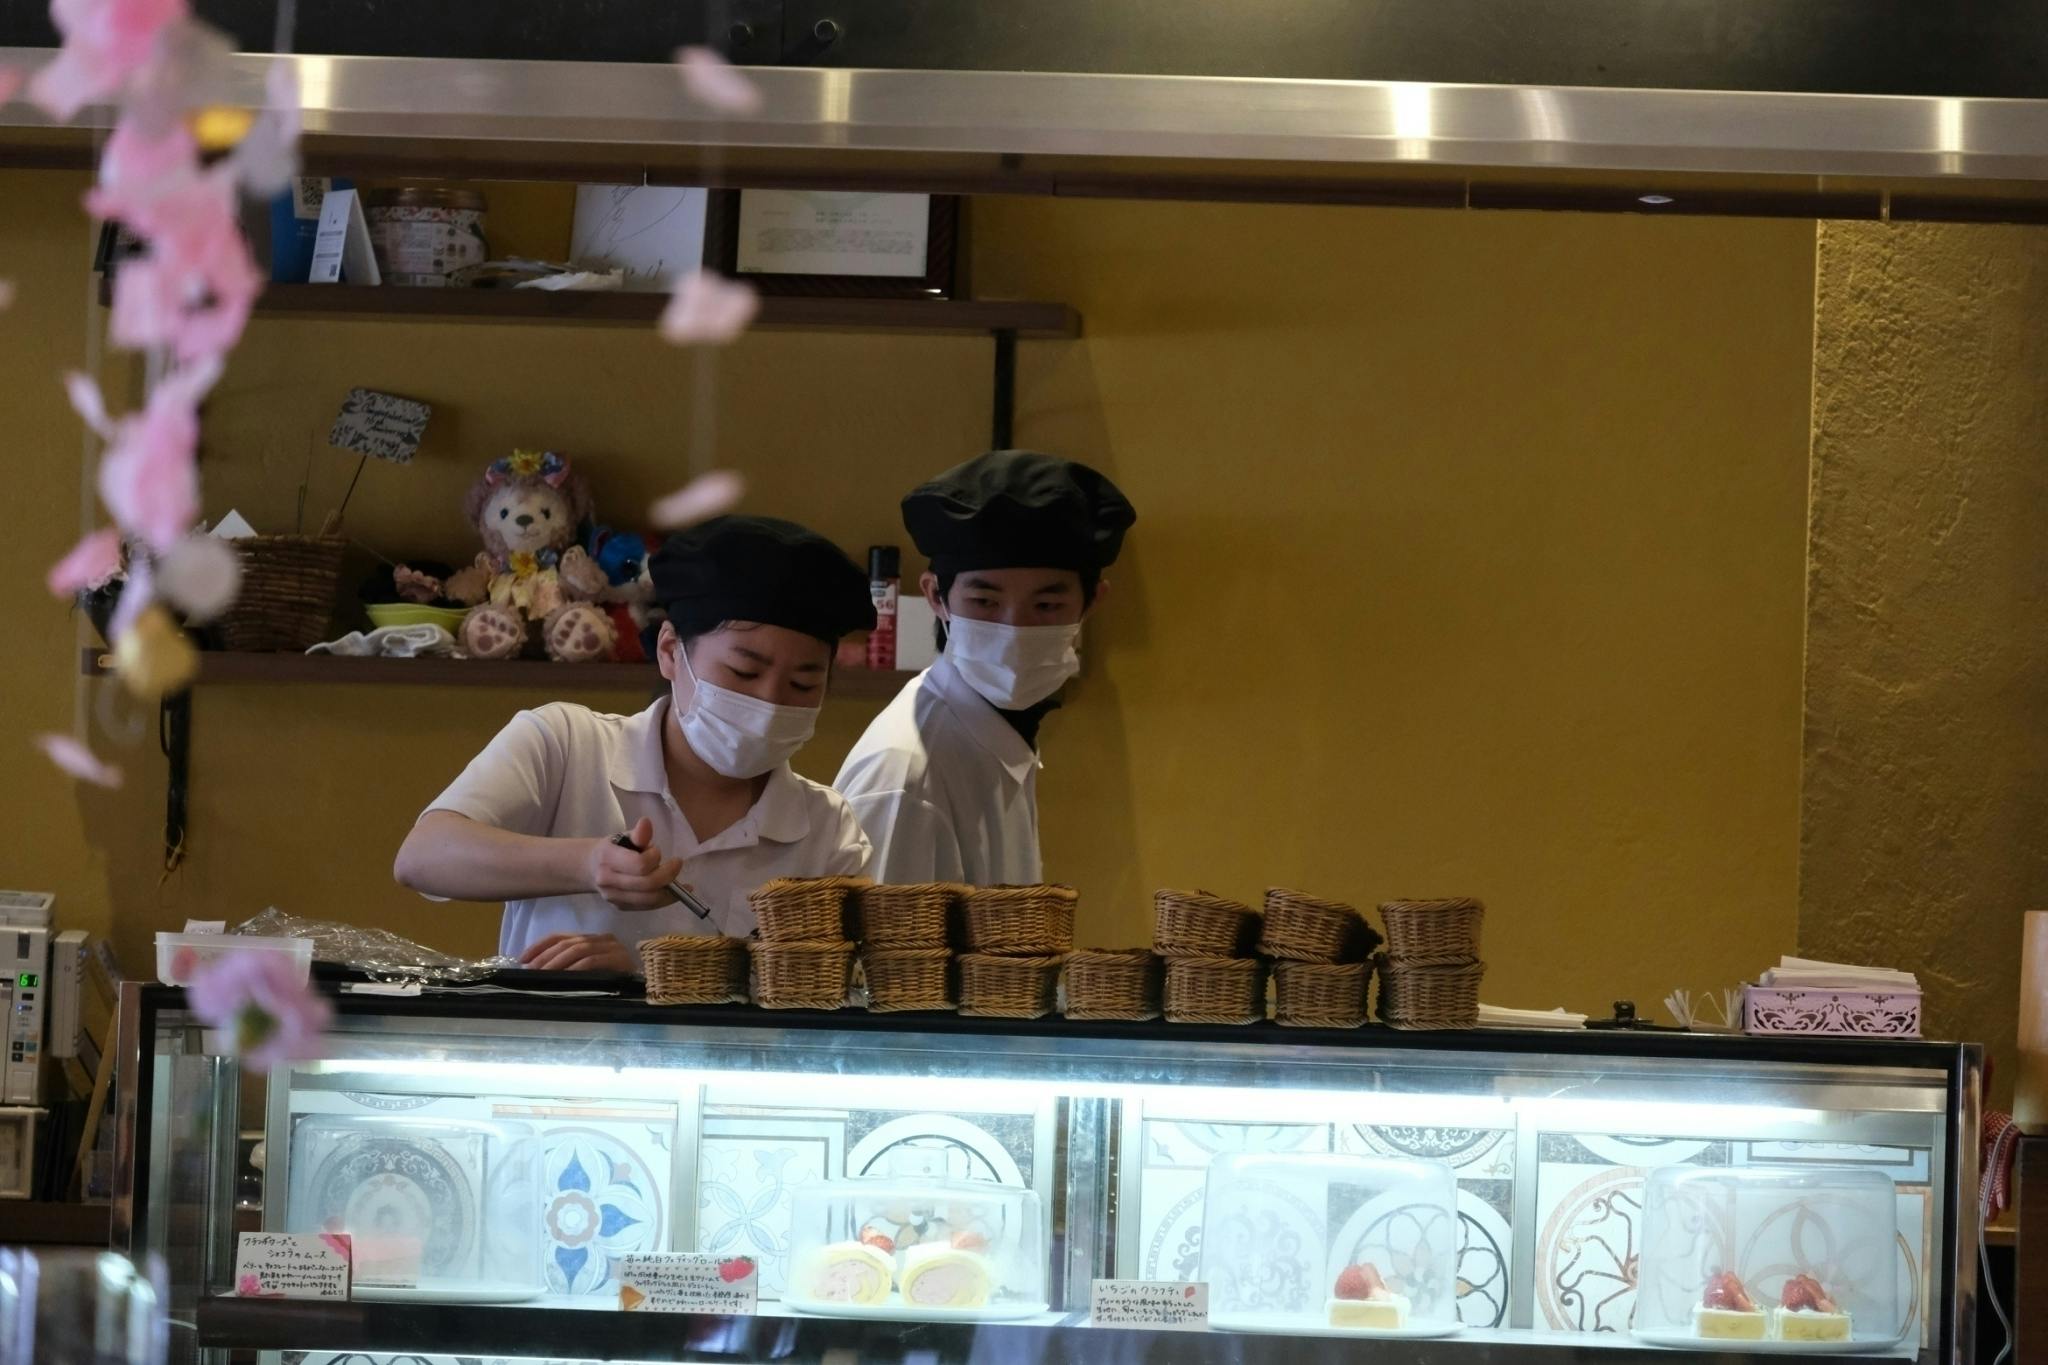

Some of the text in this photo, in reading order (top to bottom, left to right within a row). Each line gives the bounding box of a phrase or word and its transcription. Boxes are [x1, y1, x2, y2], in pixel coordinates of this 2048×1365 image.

[1099, 1285, 1180, 1295] いちごのクラフティ
